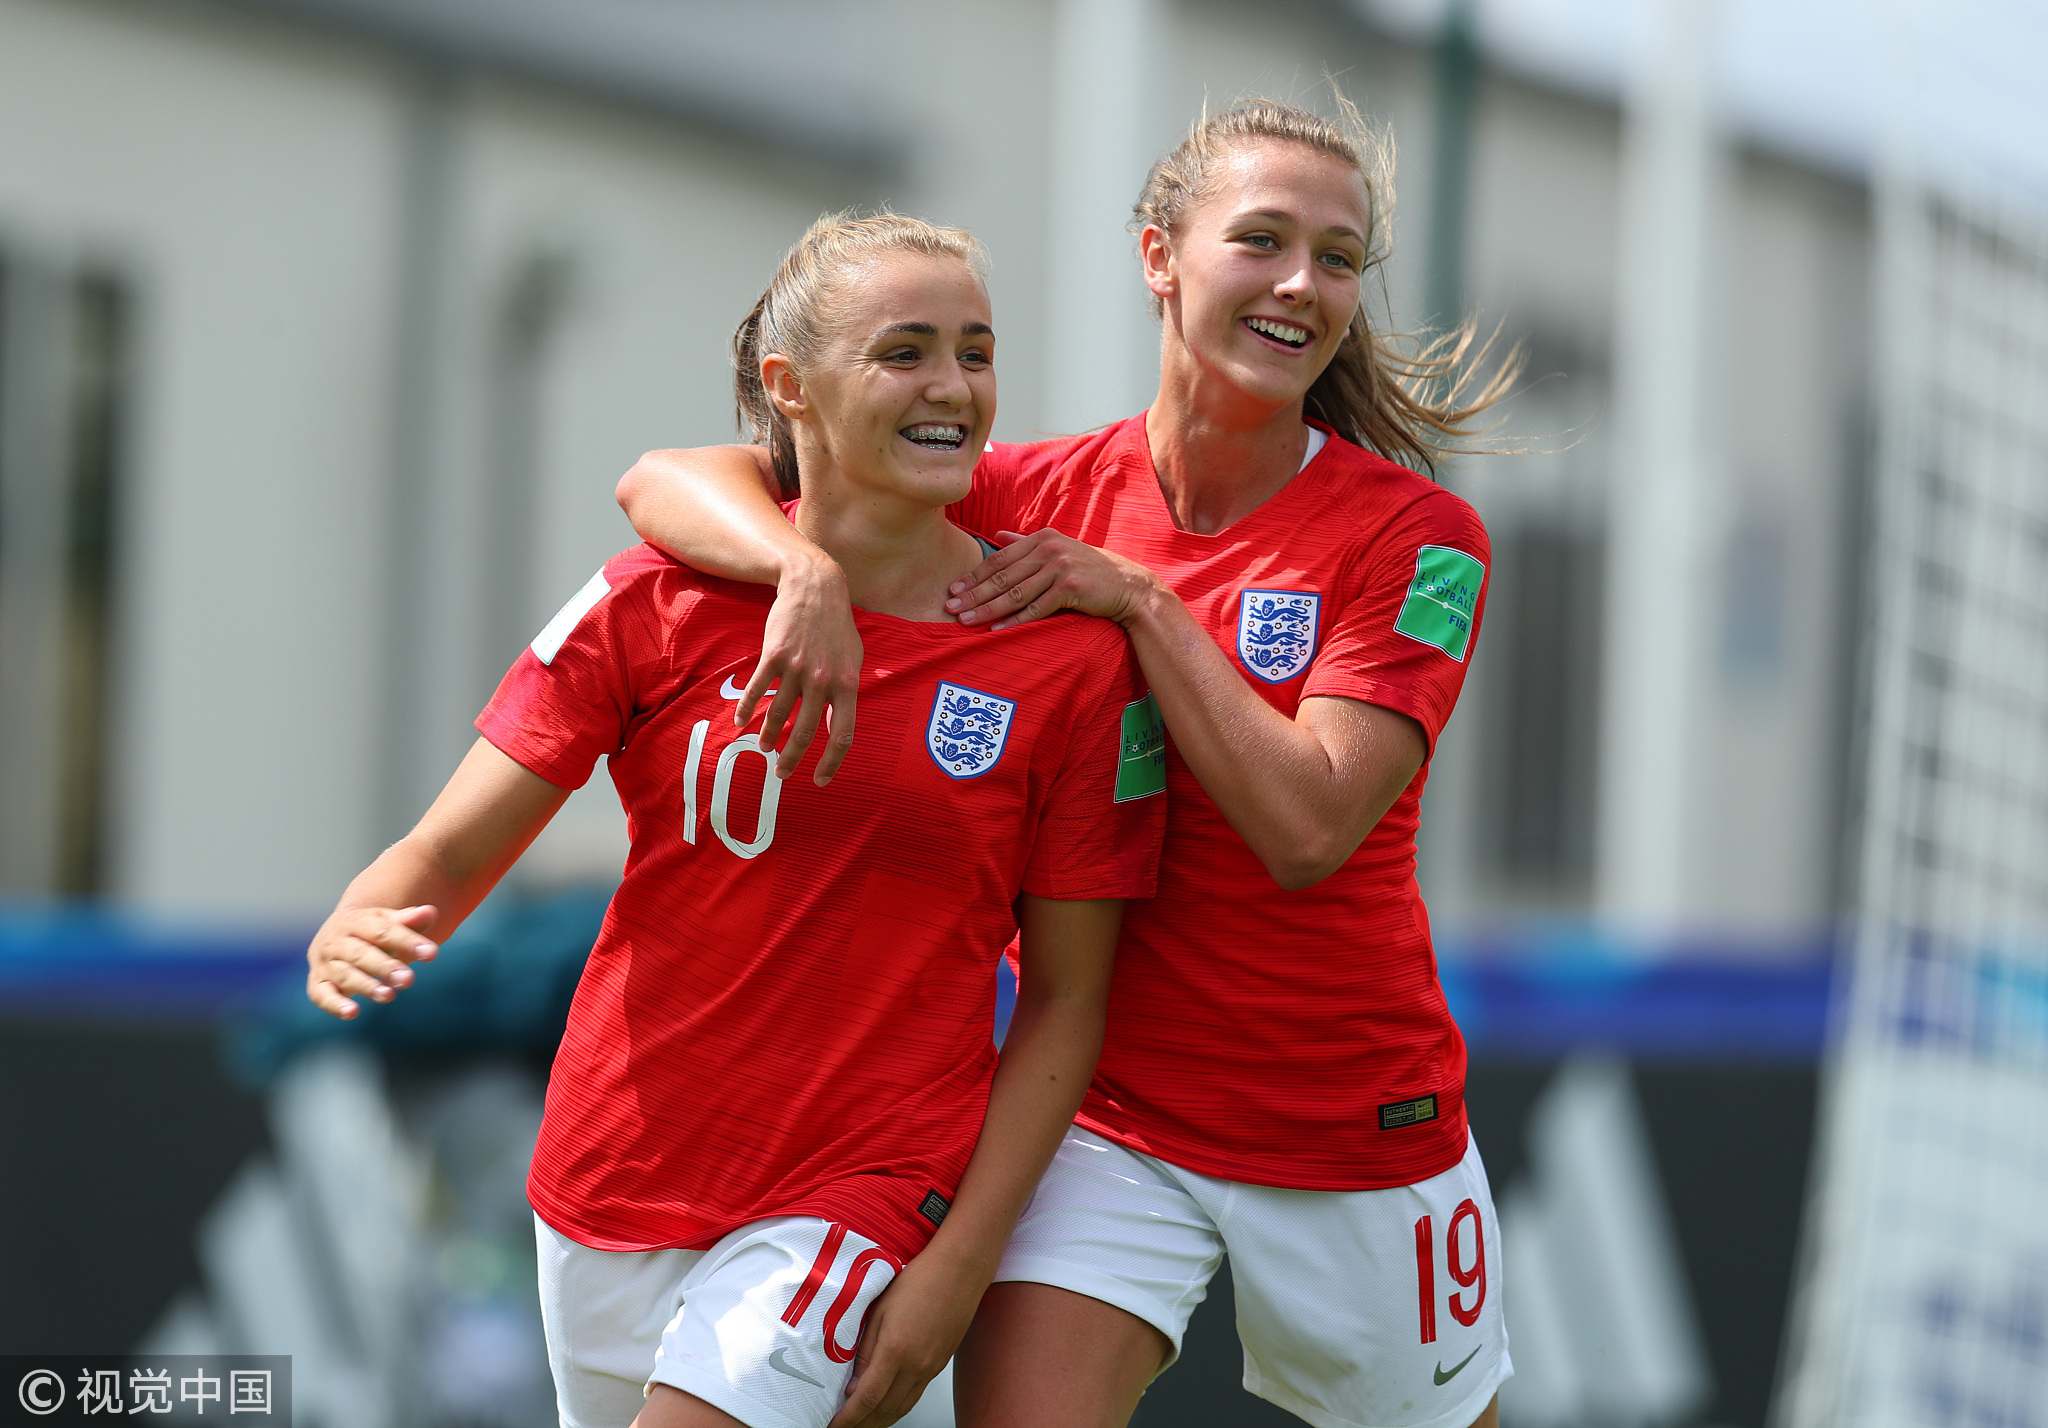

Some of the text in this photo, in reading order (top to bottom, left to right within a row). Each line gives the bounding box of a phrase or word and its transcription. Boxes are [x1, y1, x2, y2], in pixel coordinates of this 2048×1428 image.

[1420, 571, 1475, 601] LIVING
[682, 719, 784, 860] 10
[780, 1223, 903, 1364] 10
[1414, 1198, 1487, 1345] 19
